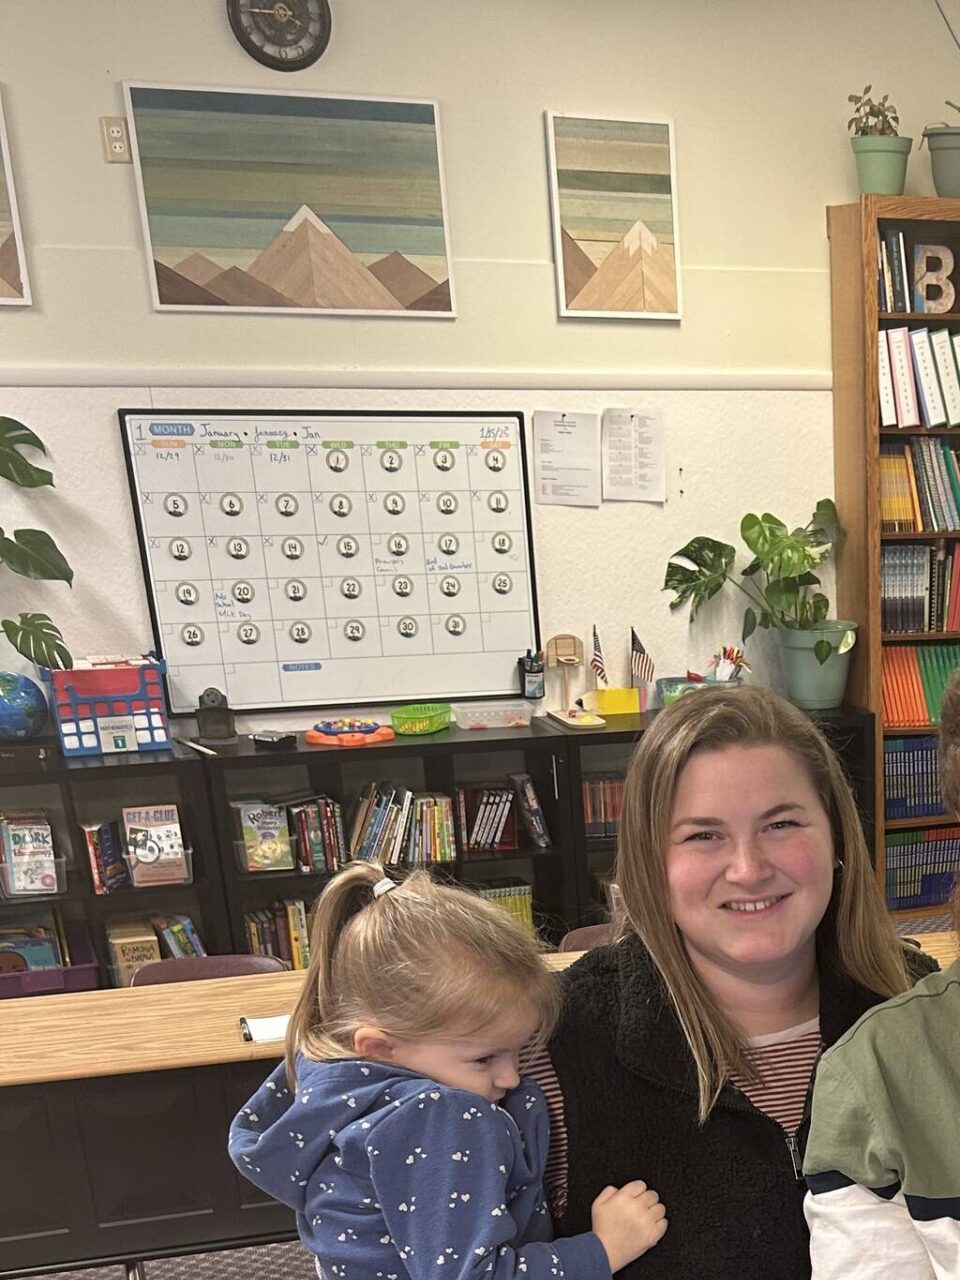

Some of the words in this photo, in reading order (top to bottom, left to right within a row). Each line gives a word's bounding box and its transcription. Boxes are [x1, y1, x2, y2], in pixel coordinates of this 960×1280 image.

[914, 244, 955, 314] B
[153, 424, 191, 435] MONTH
[200, 423, 241, 443] January
[301, 426, 321, 440] Jan
[155, 452, 180, 462] 12/29
[388, 456, 394, 466] 2
[441, 454, 448, 464] 3
[492, 456, 499, 465] 4
[172, 500, 179, 510] 5
[228, 500, 235, 509] 6
[284, 500, 290, 510] 7
[338, 500, 344, 510] 8
[392, 498, 398, 508] 9
[442, 498, 452, 508] 10
[233, 543, 243, 552] 13
[288, 542, 297, 552] 14
[344, 541, 352, 551] 15
[394, 540, 403, 550] 16
[445, 539, 452, 549] 17
[498, 538, 506, 548] 18
[176, 544, 185, 553] 12
[346, 583, 356, 592] 22
[398, 581, 408, 590] 23
[446, 581, 456, 591] 24
[498, 578, 508, 588] 25
[182, 589, 192, 598] 19
[236, 586, 250, 596] 20
[292, 585, 300, 594] 21
[350, 625, 360, 635] 29
[402, 622, 414, 632] 30
[451, 620, 460, 630] 31
[187, 630, 198, 639] 26
[242, 628, 253, 638] 27
[295, 627, 306, 637] 28
[248, 808, 282, 825] Robert
